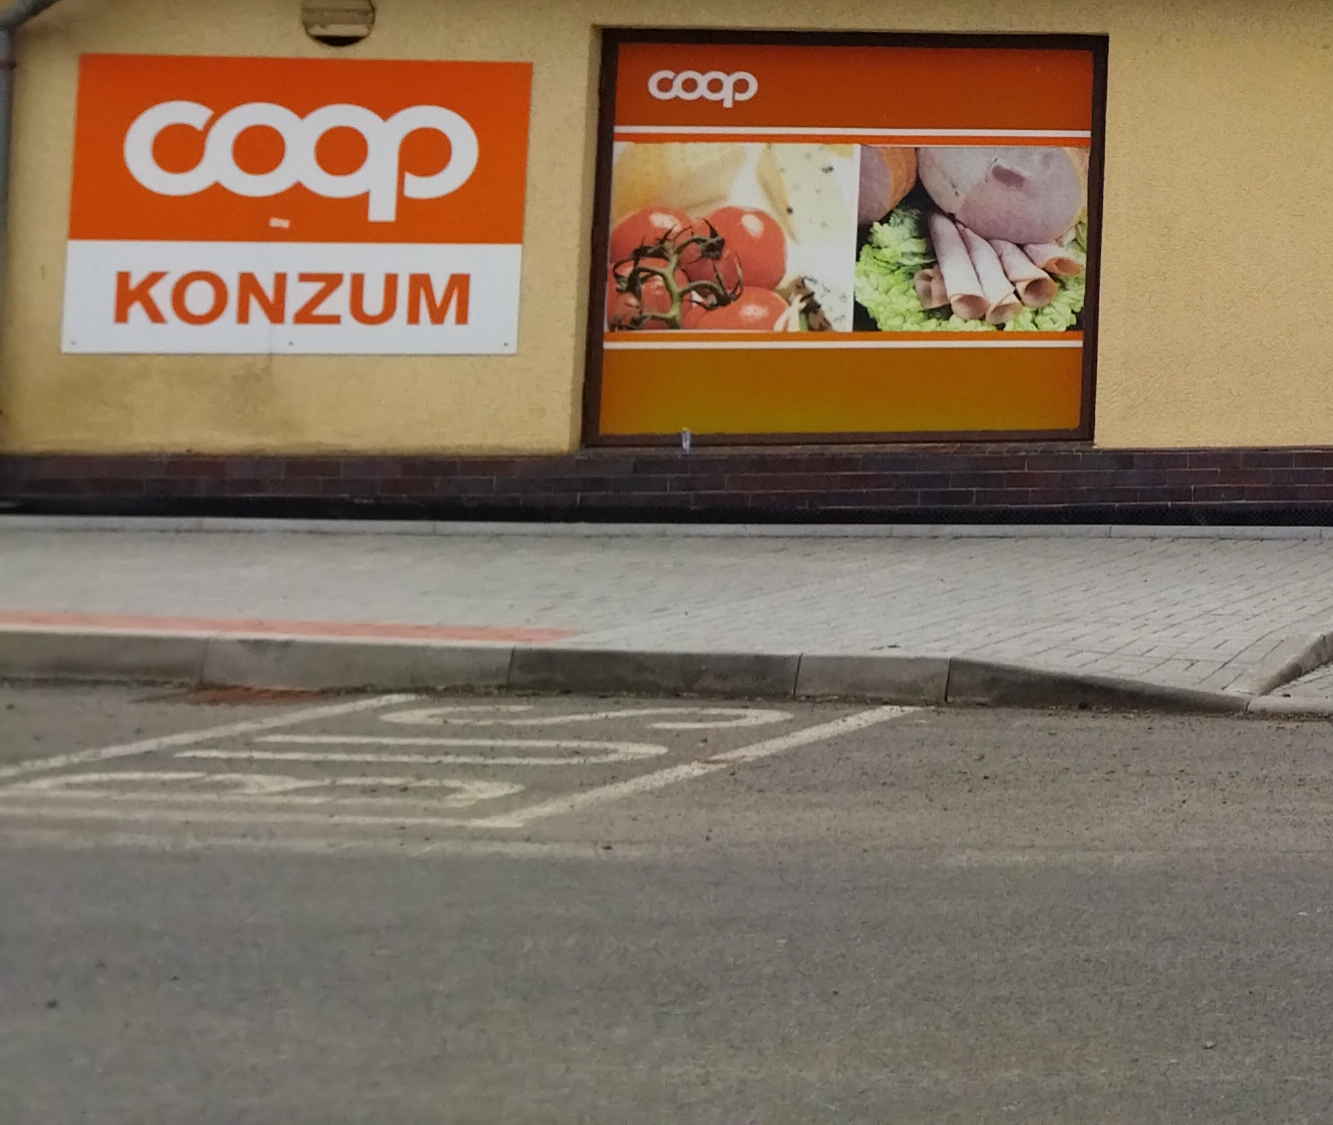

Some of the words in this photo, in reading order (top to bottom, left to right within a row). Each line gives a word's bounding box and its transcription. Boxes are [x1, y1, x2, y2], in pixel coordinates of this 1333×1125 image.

[649, 70, 758, 108] coop
[123, 100, 480, 222] coop
[114, 271, 469, 325] KONZUM
